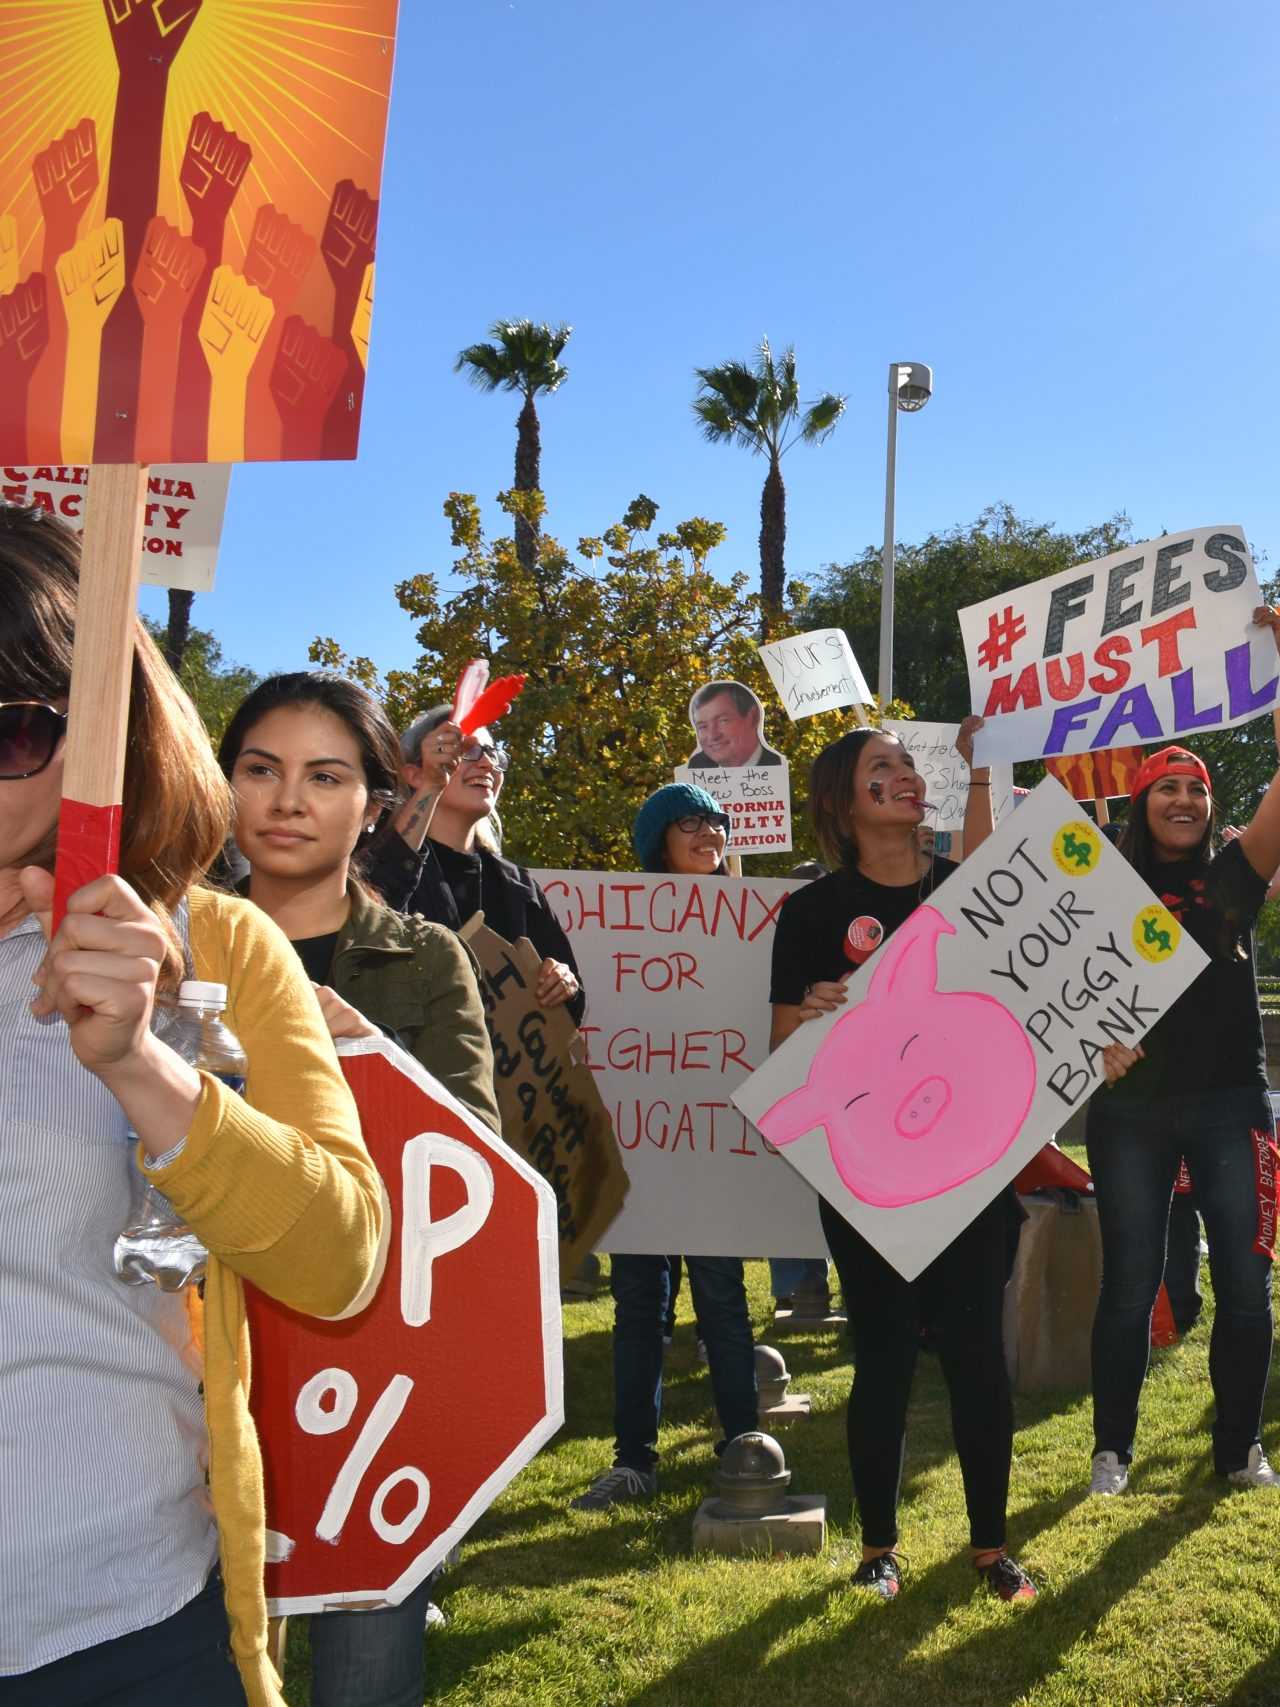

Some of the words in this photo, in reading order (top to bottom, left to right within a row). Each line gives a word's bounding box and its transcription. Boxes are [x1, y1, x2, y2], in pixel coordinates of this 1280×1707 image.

[982, 606, 1197, 718] MUST
[1042, 641, 1280, 755] FALL
[692, 770, 731, 785] Meet
[743, 769, 769, 781] the
[721, 800, 785, 814] FORNIA
[740, 782, 774, 797] Boss
[731, 815, 785, 830] ULTY
[543, 880, 791, 942] CHICANX
[960, 837, 1048, 940] NOT
[990, 890, 1095, 993] YOUR
[612, 951, 704, 993] FOR
[1026, 931, 1133, 1054] PIGGY
[578, 1026, 755, 1074] IGHER
[1046, 984, 1159, 1106] BANK
[1258, 1192, 1277, 1251] MONEY
